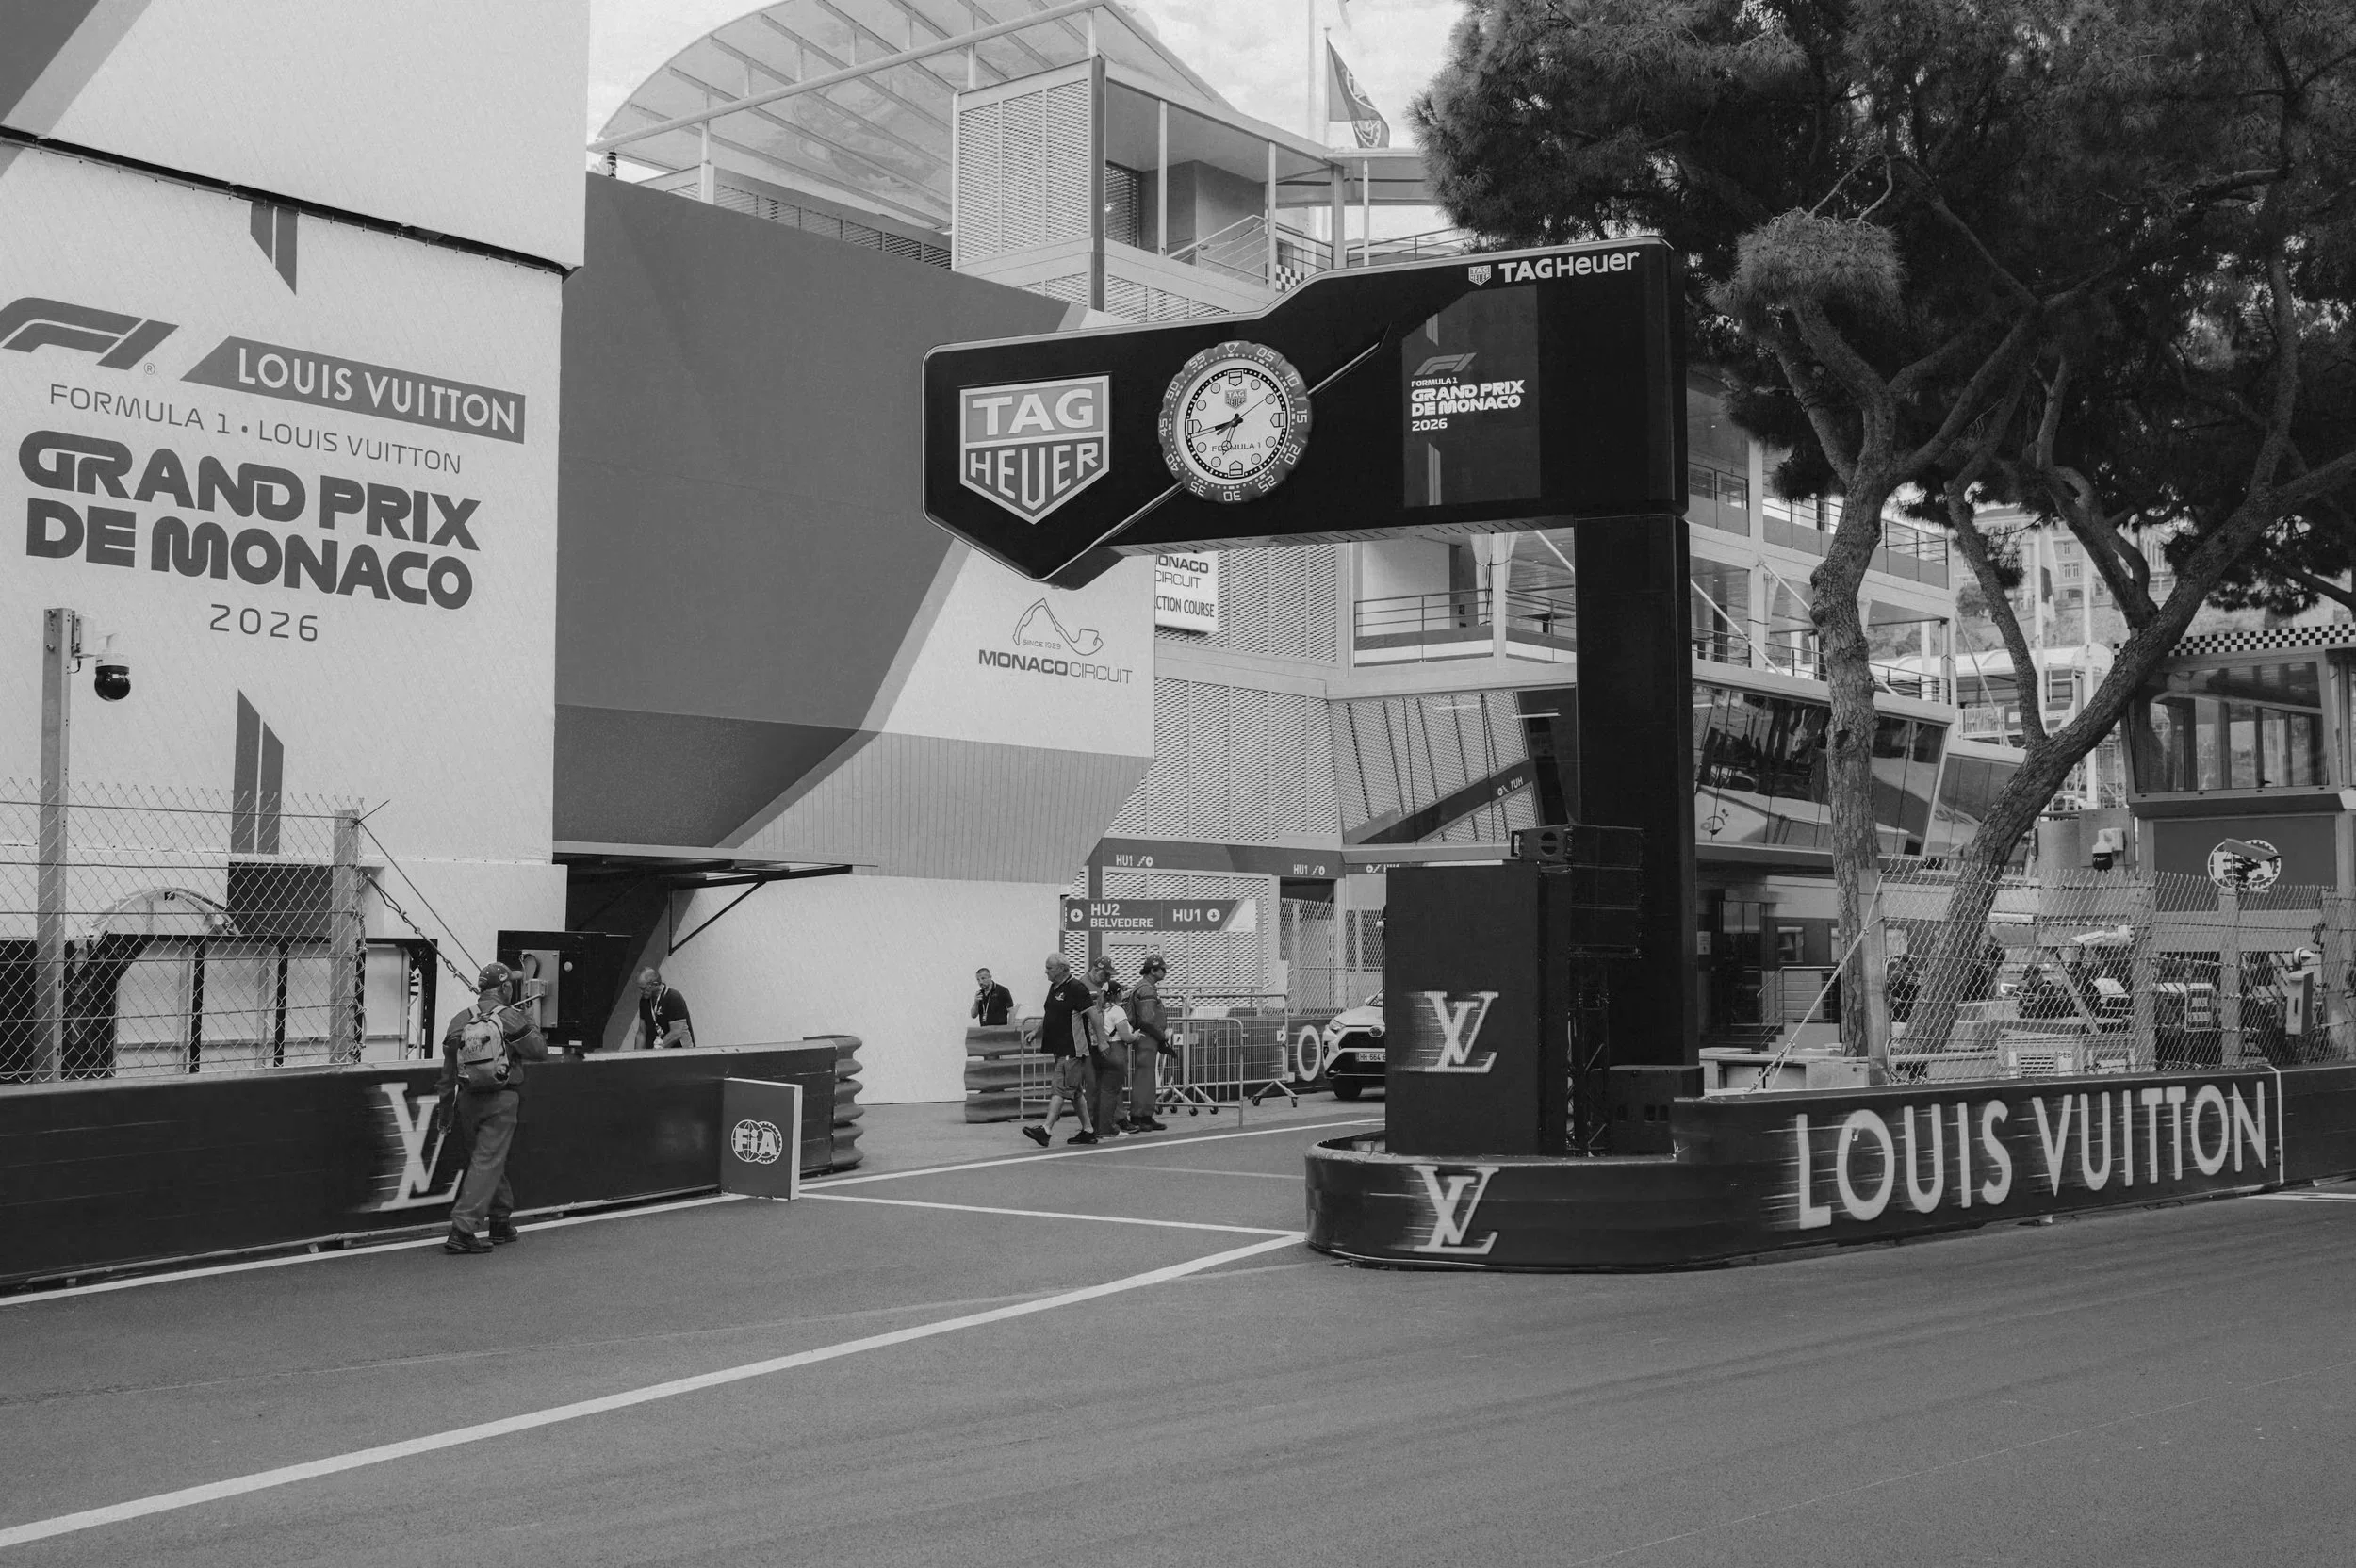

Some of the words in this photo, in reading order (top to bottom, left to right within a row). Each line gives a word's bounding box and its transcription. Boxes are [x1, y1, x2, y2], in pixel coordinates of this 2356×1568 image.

[1189, 353, 1205, 369] 55
[1256, 347, 1276, 362] 05
[1285, 371, 1300, 388] 10
[1411, 378, 1451, 387] FORMULA
[238, 347, 352, 402] LOUIS
[364, 371, 515, 434] VUITTON
[1166, 380, 1179, 400] 50
[1411, 384, 1477, 402] GRAND
[1480, 380, 1525, 397] PRIX
[973, 388, 1094, 436] TAG
[1412, 401, 1436, 416] DE
[1438, 395, 1521, 415] MONACO
[1296, 409, 1308, 423] 15
[1412, 418, 1448, 431] 2026
[50, 384, 204, 431] FORMULA
[217, 413, 230, 434] 1
[259, 419, 338, 452] LOUIS
[347, 435, 461, 474] VUITTON
[1159, 418, 1169, 437] 45
[1284, 444, 1301, 465] 20
[970, 442, 1098, 511] HEUER
[18, 430, 306, 523] GRAND
[319, 474, 482, 551] PRIX
[1223, 490, 1242, 502] 30
[26, 497, 137, 567] DE
[151, 515, 472, 610] MONACO
[1184, 599, 1215, 618] COURSE
[209, 603, 319, 641] 2026
[1023, 639, 1044, 648] SINCE
[1045, 641, 1061, 650] 1929
[1116, 854, 1133, 867] HU1
[1293, 864, 1308, 874] HU1
[1090, 903, 1120, 916] HU2
[1172, 908, 1201, 922] HU1
[1090, 918, 1153, 928] BELVEDERE
[1796, 1099, 2012, 1229] LOUIS
[2032, 1081, 2266, 1197] VUITTON
